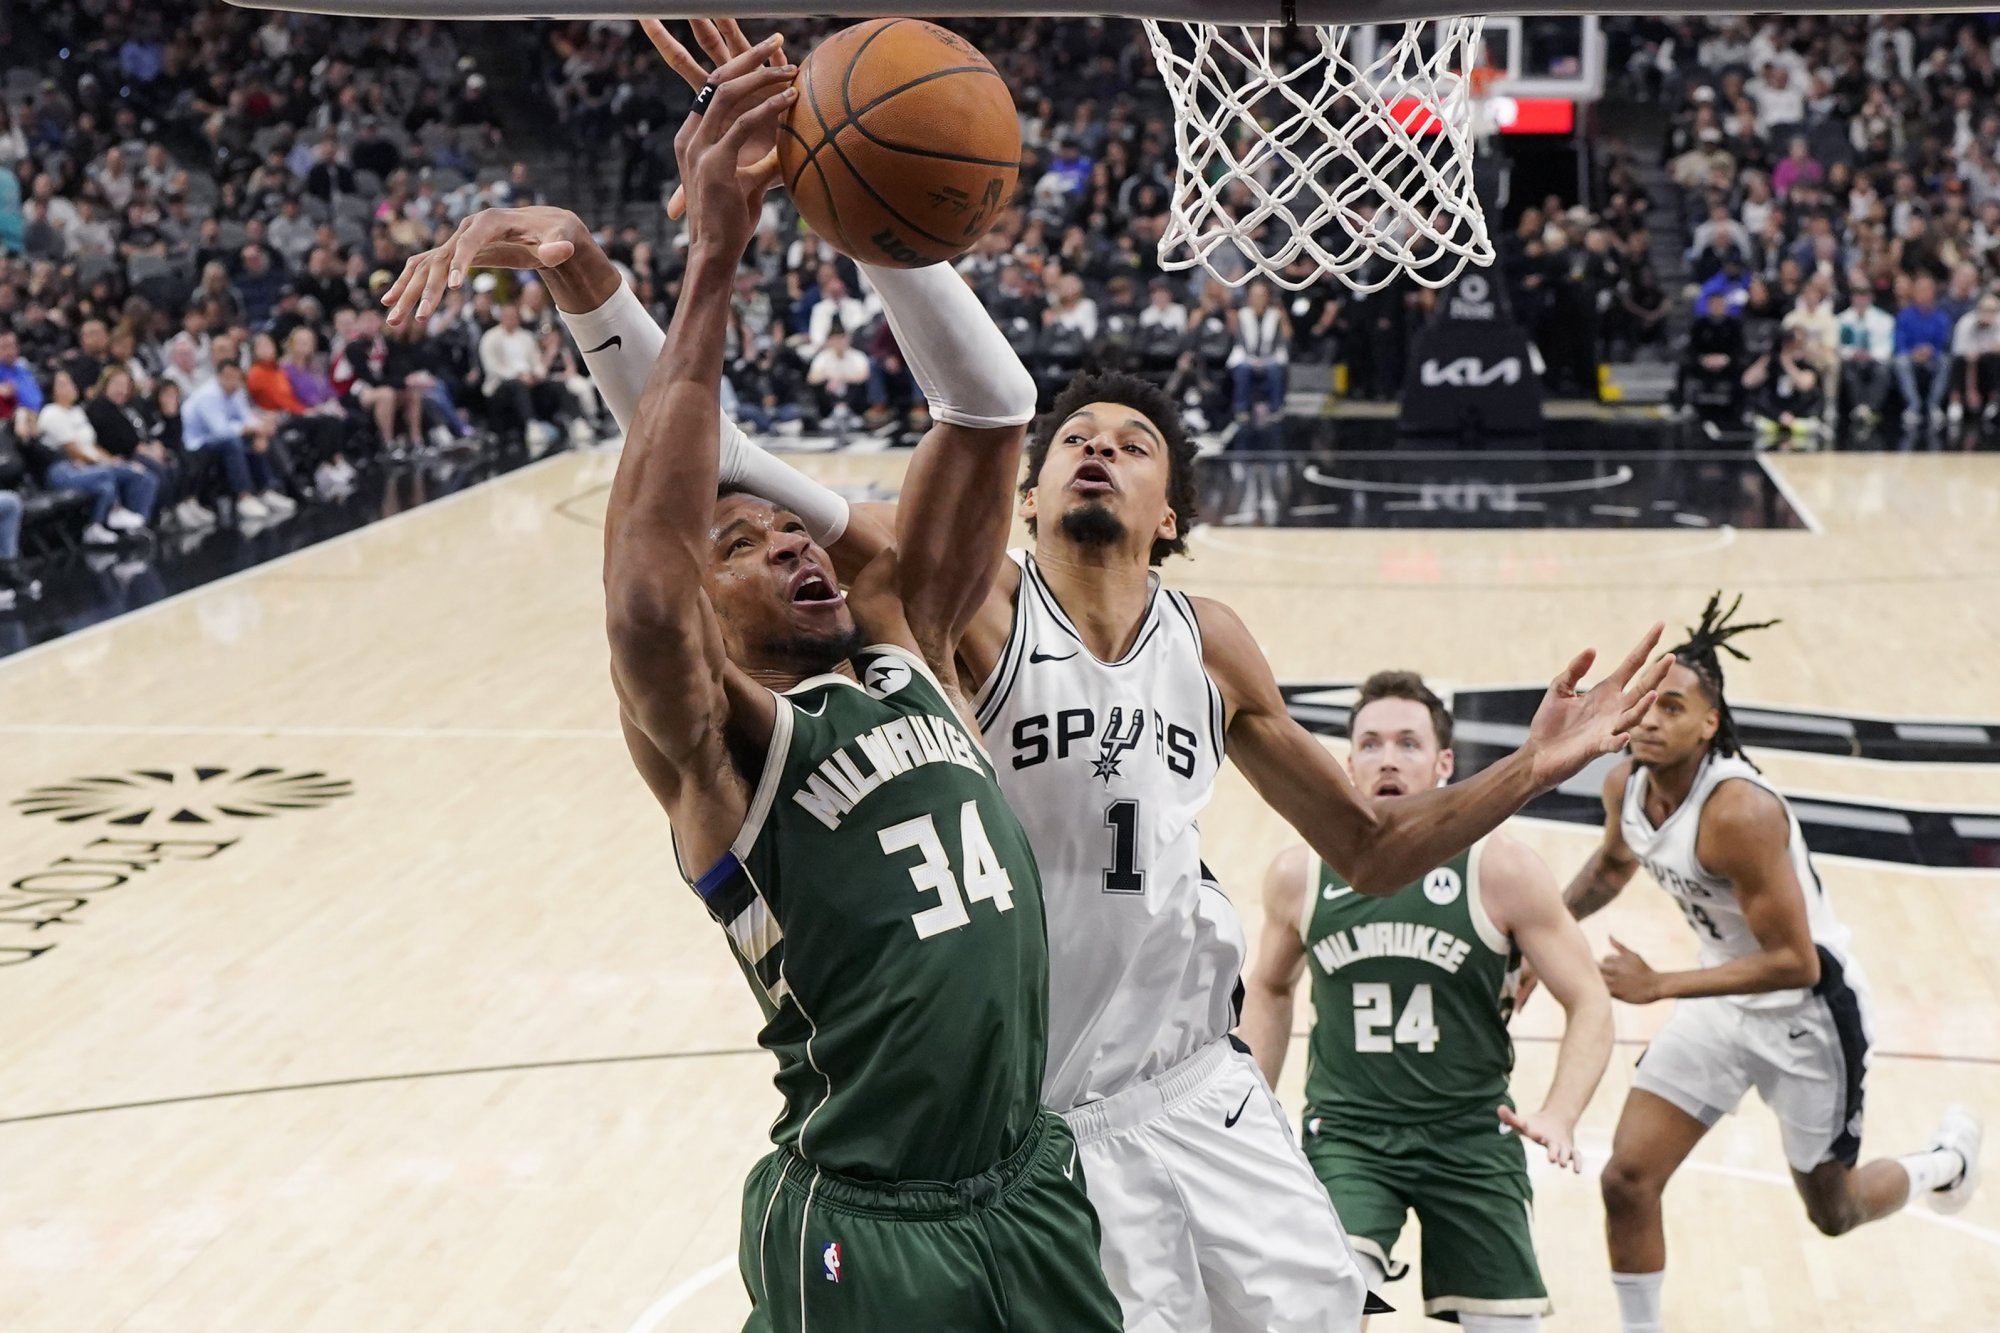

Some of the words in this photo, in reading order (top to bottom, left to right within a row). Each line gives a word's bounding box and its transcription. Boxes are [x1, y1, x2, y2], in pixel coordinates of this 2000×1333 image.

[876, 799, 1014, 940] 34
[1101, 799, 1146, 895] 1
[1312, 922, 1472, 976] MILWAUKEE
[1352, 982, 1440, 1053] 24
